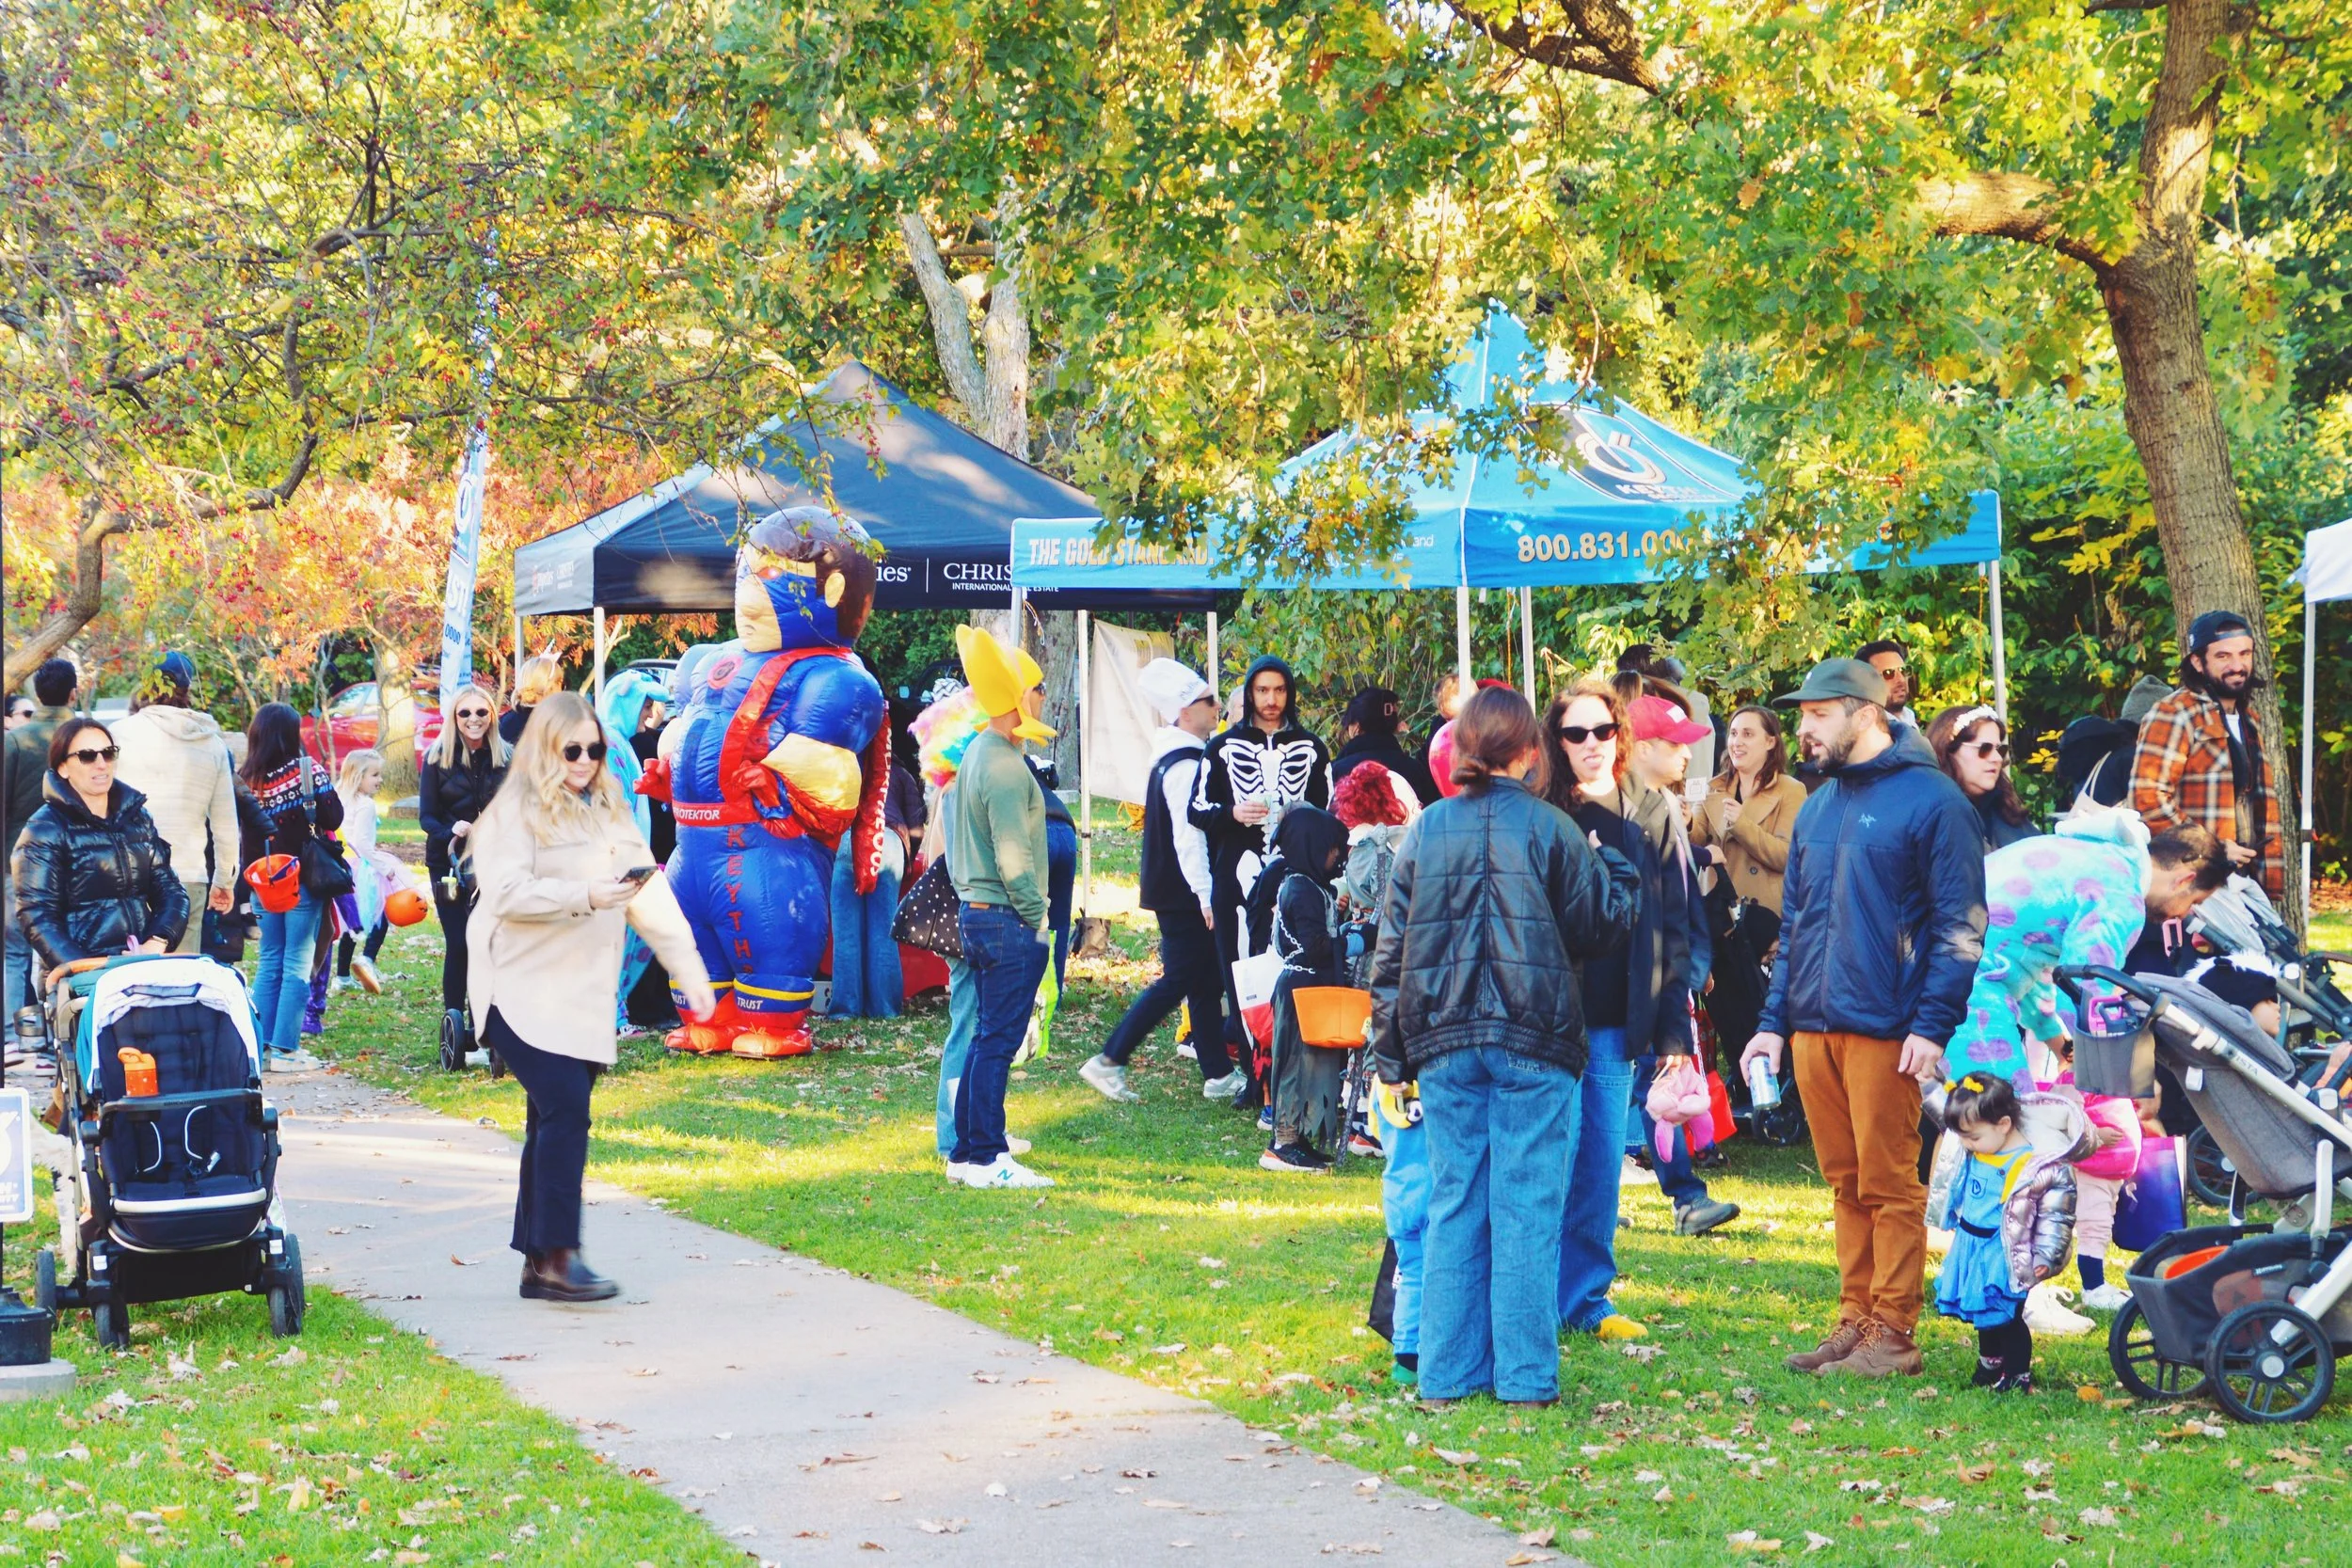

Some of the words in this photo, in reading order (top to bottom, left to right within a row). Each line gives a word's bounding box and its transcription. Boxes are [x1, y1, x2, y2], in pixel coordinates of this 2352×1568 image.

[1028, 538, 1061, 565] THE
[943, 562, 1012, 580] CHRIS
[952, 581, 1012, 592] INTERNATIONAL
[737, 996, 764, 1010] TRUST
